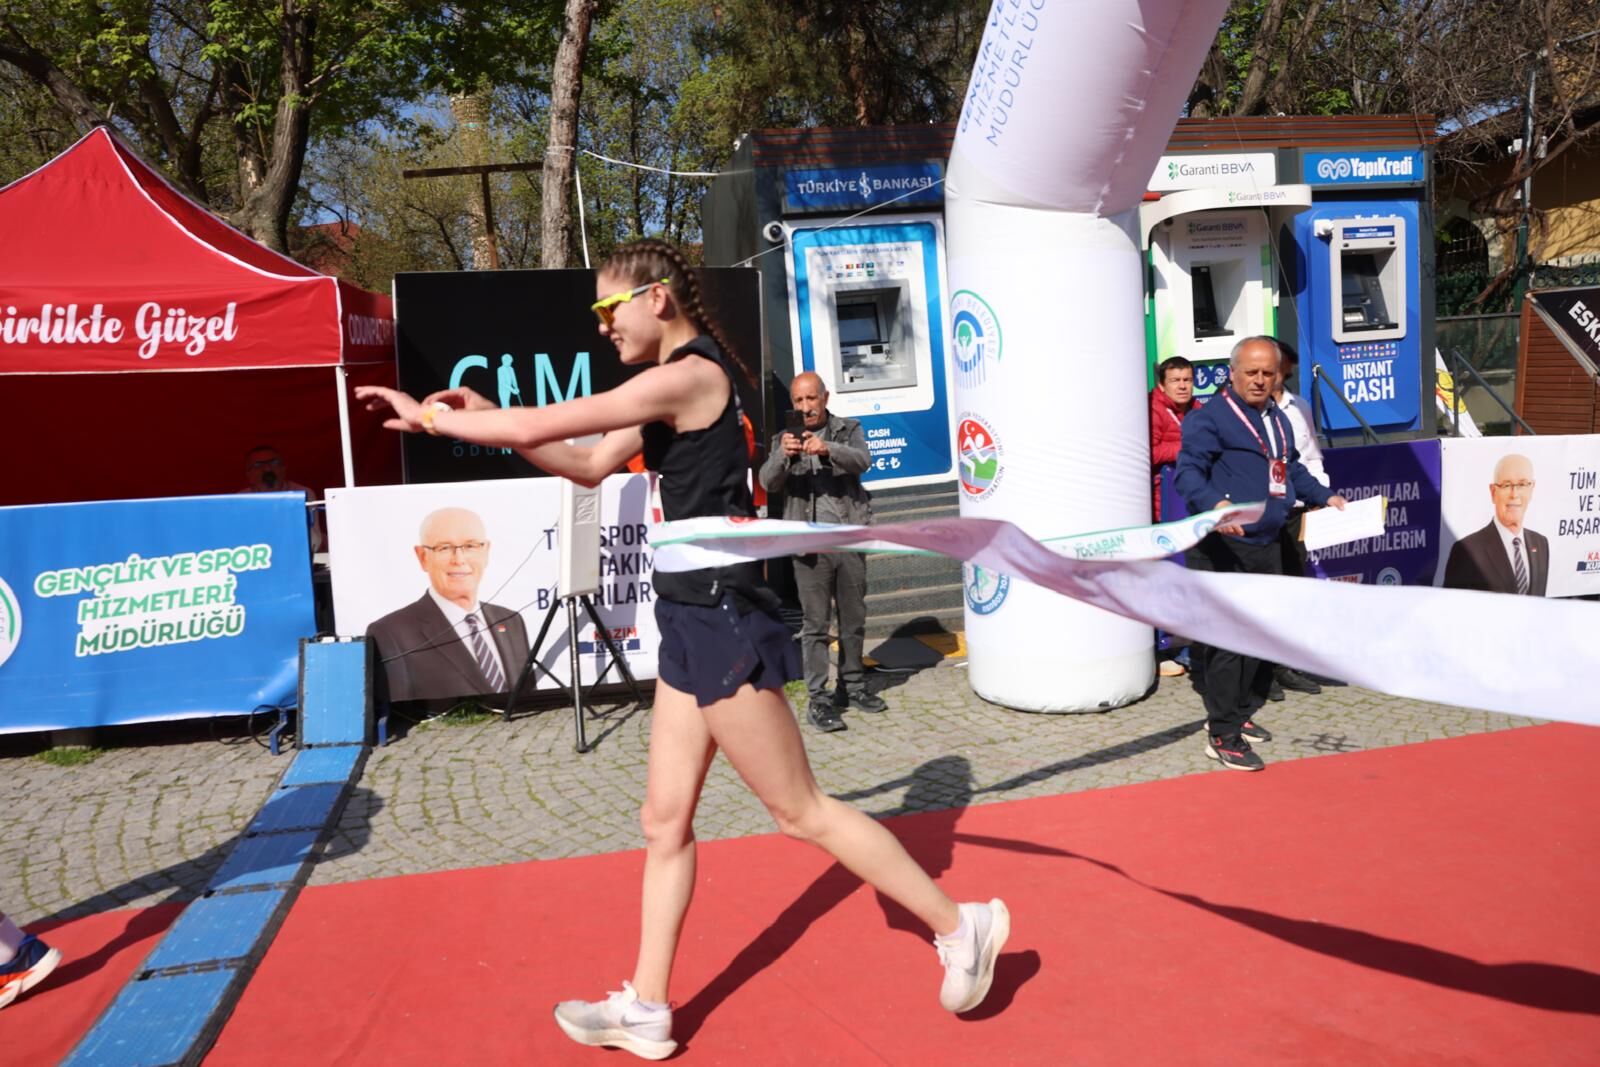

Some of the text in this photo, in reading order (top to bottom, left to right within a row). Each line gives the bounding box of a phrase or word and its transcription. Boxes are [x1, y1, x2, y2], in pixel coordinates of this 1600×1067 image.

[1180, 162, 1255, 176] Garanti BBVA
[797, 179, 857, 195] TÜRKİYE
[872, 177, 933, 190] BANKASI
[1236, 191, 1287, 201] Garanti BBVA
[0, 302, 238, 360] irlikte Güzel
[1343, 360, 1393, 380] INSTANT
[1344, 377, 1395, 403] CASH
[867, 428, 891, 438] CASH
[1570, 467, 1597, 490] TÜM
[1579, 495, 1594, 512] VE
[36, 546, 269, 595] GENÇLİK VE SPOR
[80, 577, 236, 622] HİZMETLERİ
[79, 607, 243, 655] MÜDÜRLÜĞÜ
